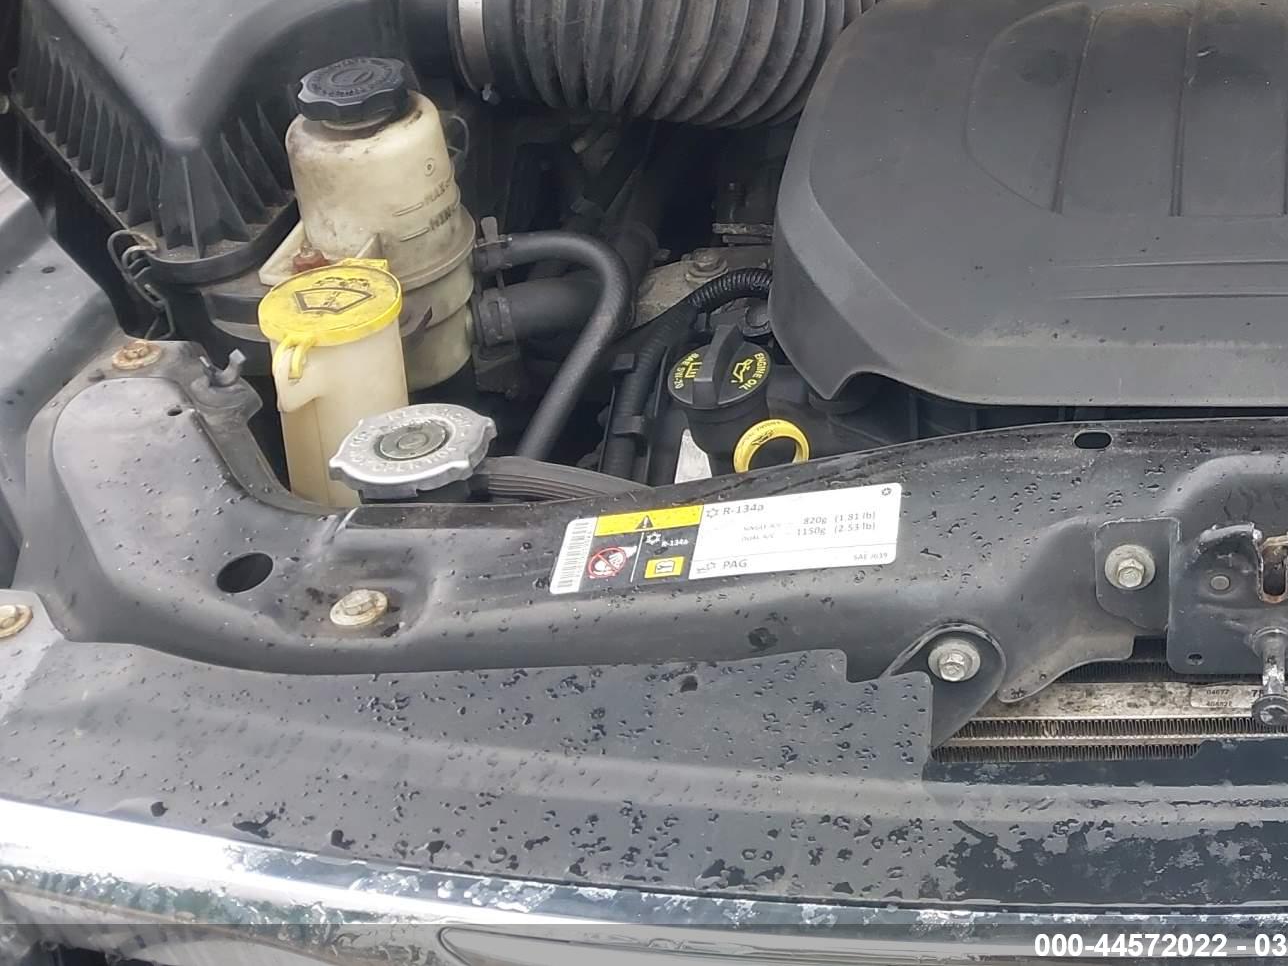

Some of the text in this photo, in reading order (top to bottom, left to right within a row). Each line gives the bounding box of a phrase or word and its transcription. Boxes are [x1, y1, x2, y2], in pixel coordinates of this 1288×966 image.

[738, 352, 768, 391] ENGINE OIL
[723, 504, 765, 515] R-134a
[803, 516, 828, 525] 820g
[797, 527, 826, 537] 1150g
[723, 559, 748, 569] PAG
